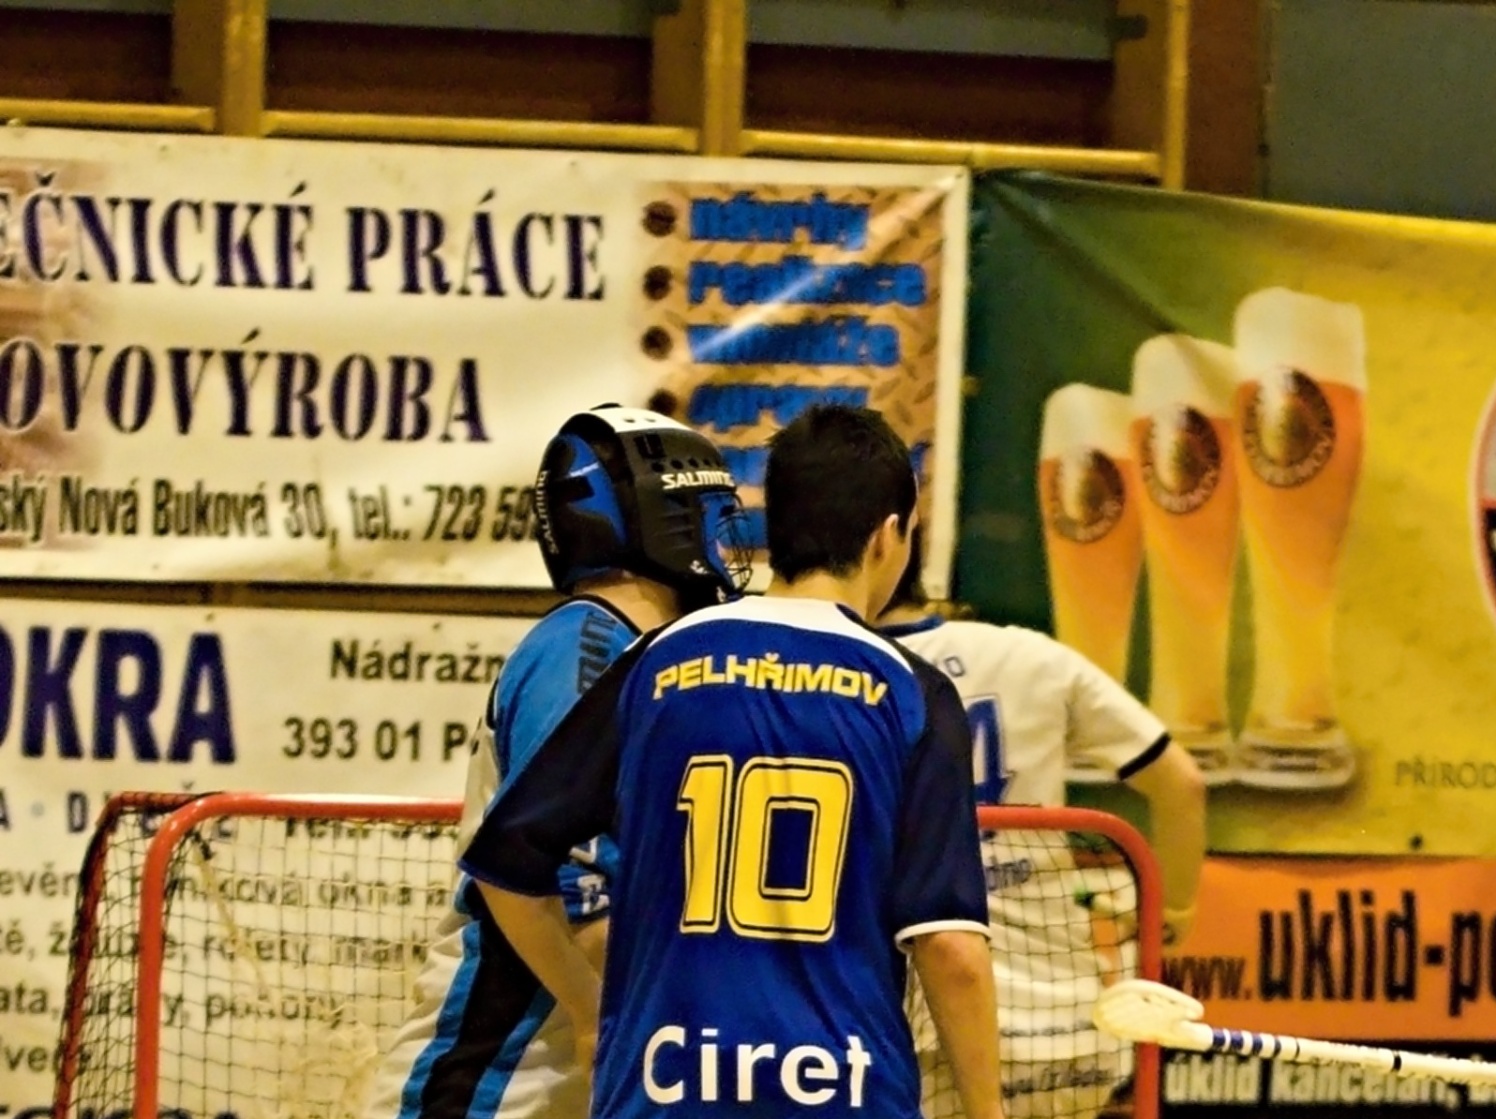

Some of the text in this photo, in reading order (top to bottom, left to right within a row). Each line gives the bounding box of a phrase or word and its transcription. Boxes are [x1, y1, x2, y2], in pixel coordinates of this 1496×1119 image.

[346, 188, 606, 301] PRÁCE
[59, 476, 139, 536] Nová
[153, 479, 269, 537] Buková
[281, 482, 337, 551] 30,
[348, 485, 412, 541] tel.:
[423, 485, 487, 541] 723
[0, 625, 236, 765] KRA
[653, 652, 888, 706] PELHŘIMOV
[282, 716, 358, 759] 393
[375, 718, 421, 762] 01
[675, 752, 855, 943] 10
[642, 1024, 872, 1108] Ciret
